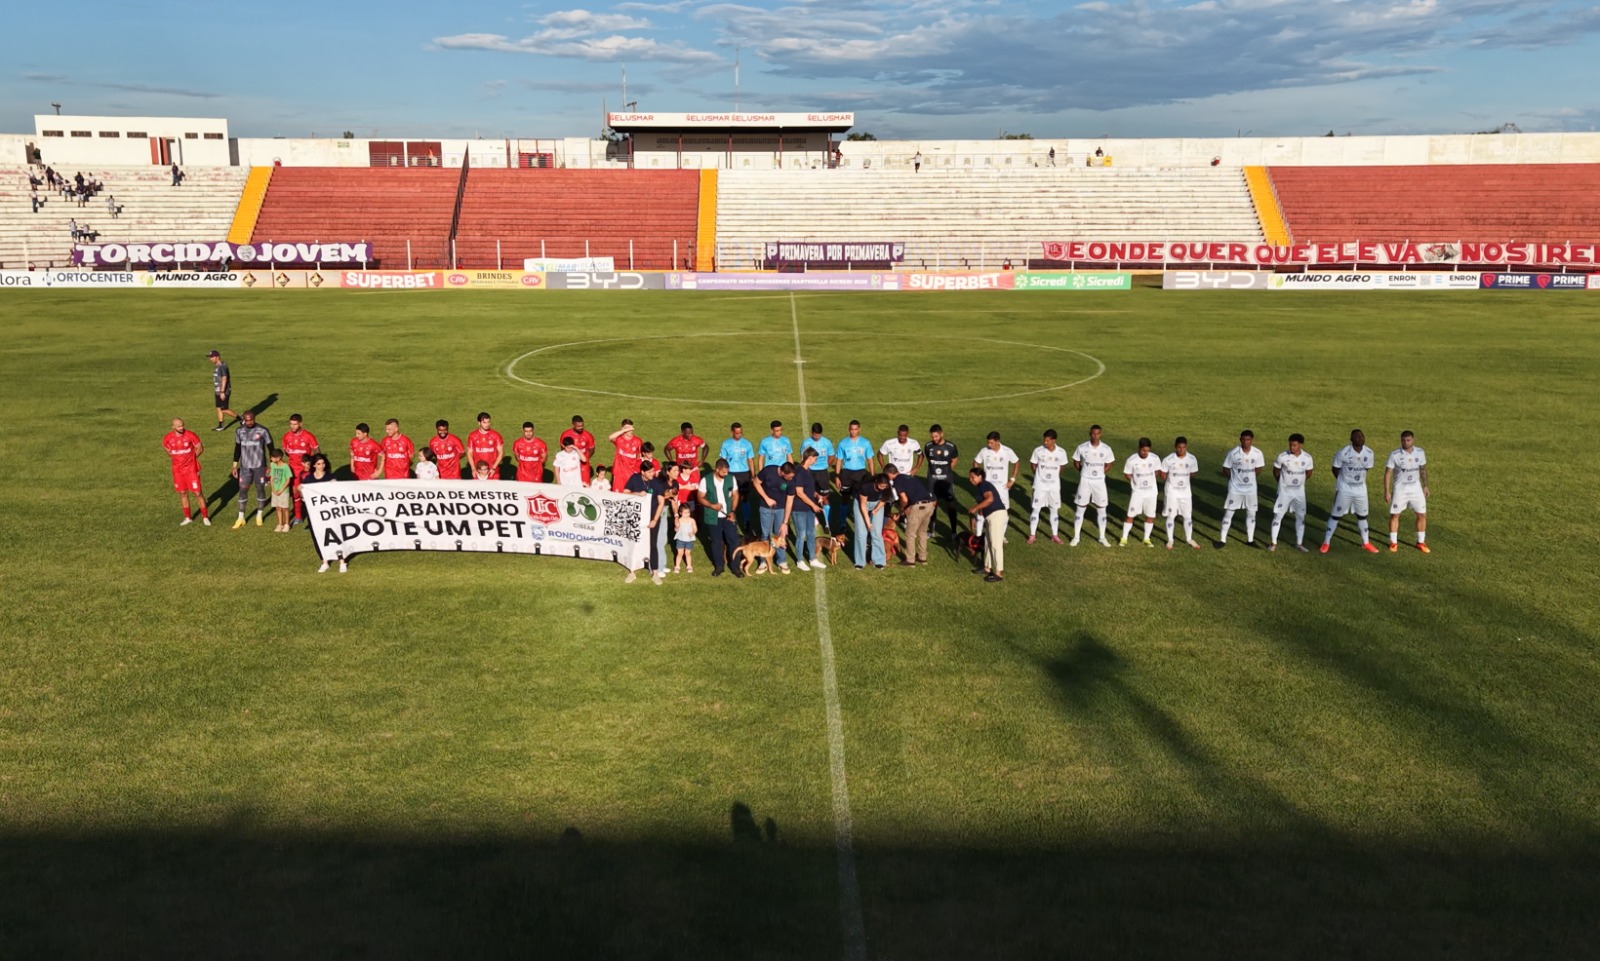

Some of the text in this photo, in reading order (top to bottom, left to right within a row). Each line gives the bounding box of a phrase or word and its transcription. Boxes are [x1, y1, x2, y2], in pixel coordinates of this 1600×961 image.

[75, 243, 368, 263] TORCIDA JOVEM
[780, 244, 891, 261] PRIMAVERA POR PRIMAVERA
[1169, 243, 1248, 261] QUER
[1255, 244, 1310, 263] QUE
[57, 272, 134, 283] ORTOCENTER
[154, 273, 238, 282] MUNDO AGRO
[345, 272, 436, 288] SUPERBET
[476, 272, 513, 280] BRINDES
[566, 272, 644, 289] BYD
[909, 273, 1000, 289] SUPERBET
[1030, 276, 1067, 287] Sicredi
[1087, 276, 1125, 287] Sicredi
[1175, 272, 1256, 288] BYD
[1285, 274, 1371, 283] MUNDO AGRO
[1498, 275, 1531, 284] PRIME
[1553, 275, 1586, 285] PRIME
[351, 492, 385, 503] UMA
[388, 491, 446, 501] JOGADA
[448, 491, 465, 500] DE
[468, 491, 519, 501] MESTRE
[375, 506, 388, 518] O
[395, 502, 519, 518] ABANDONO
[323, 518, 526, 547] ADOTE UM PET
